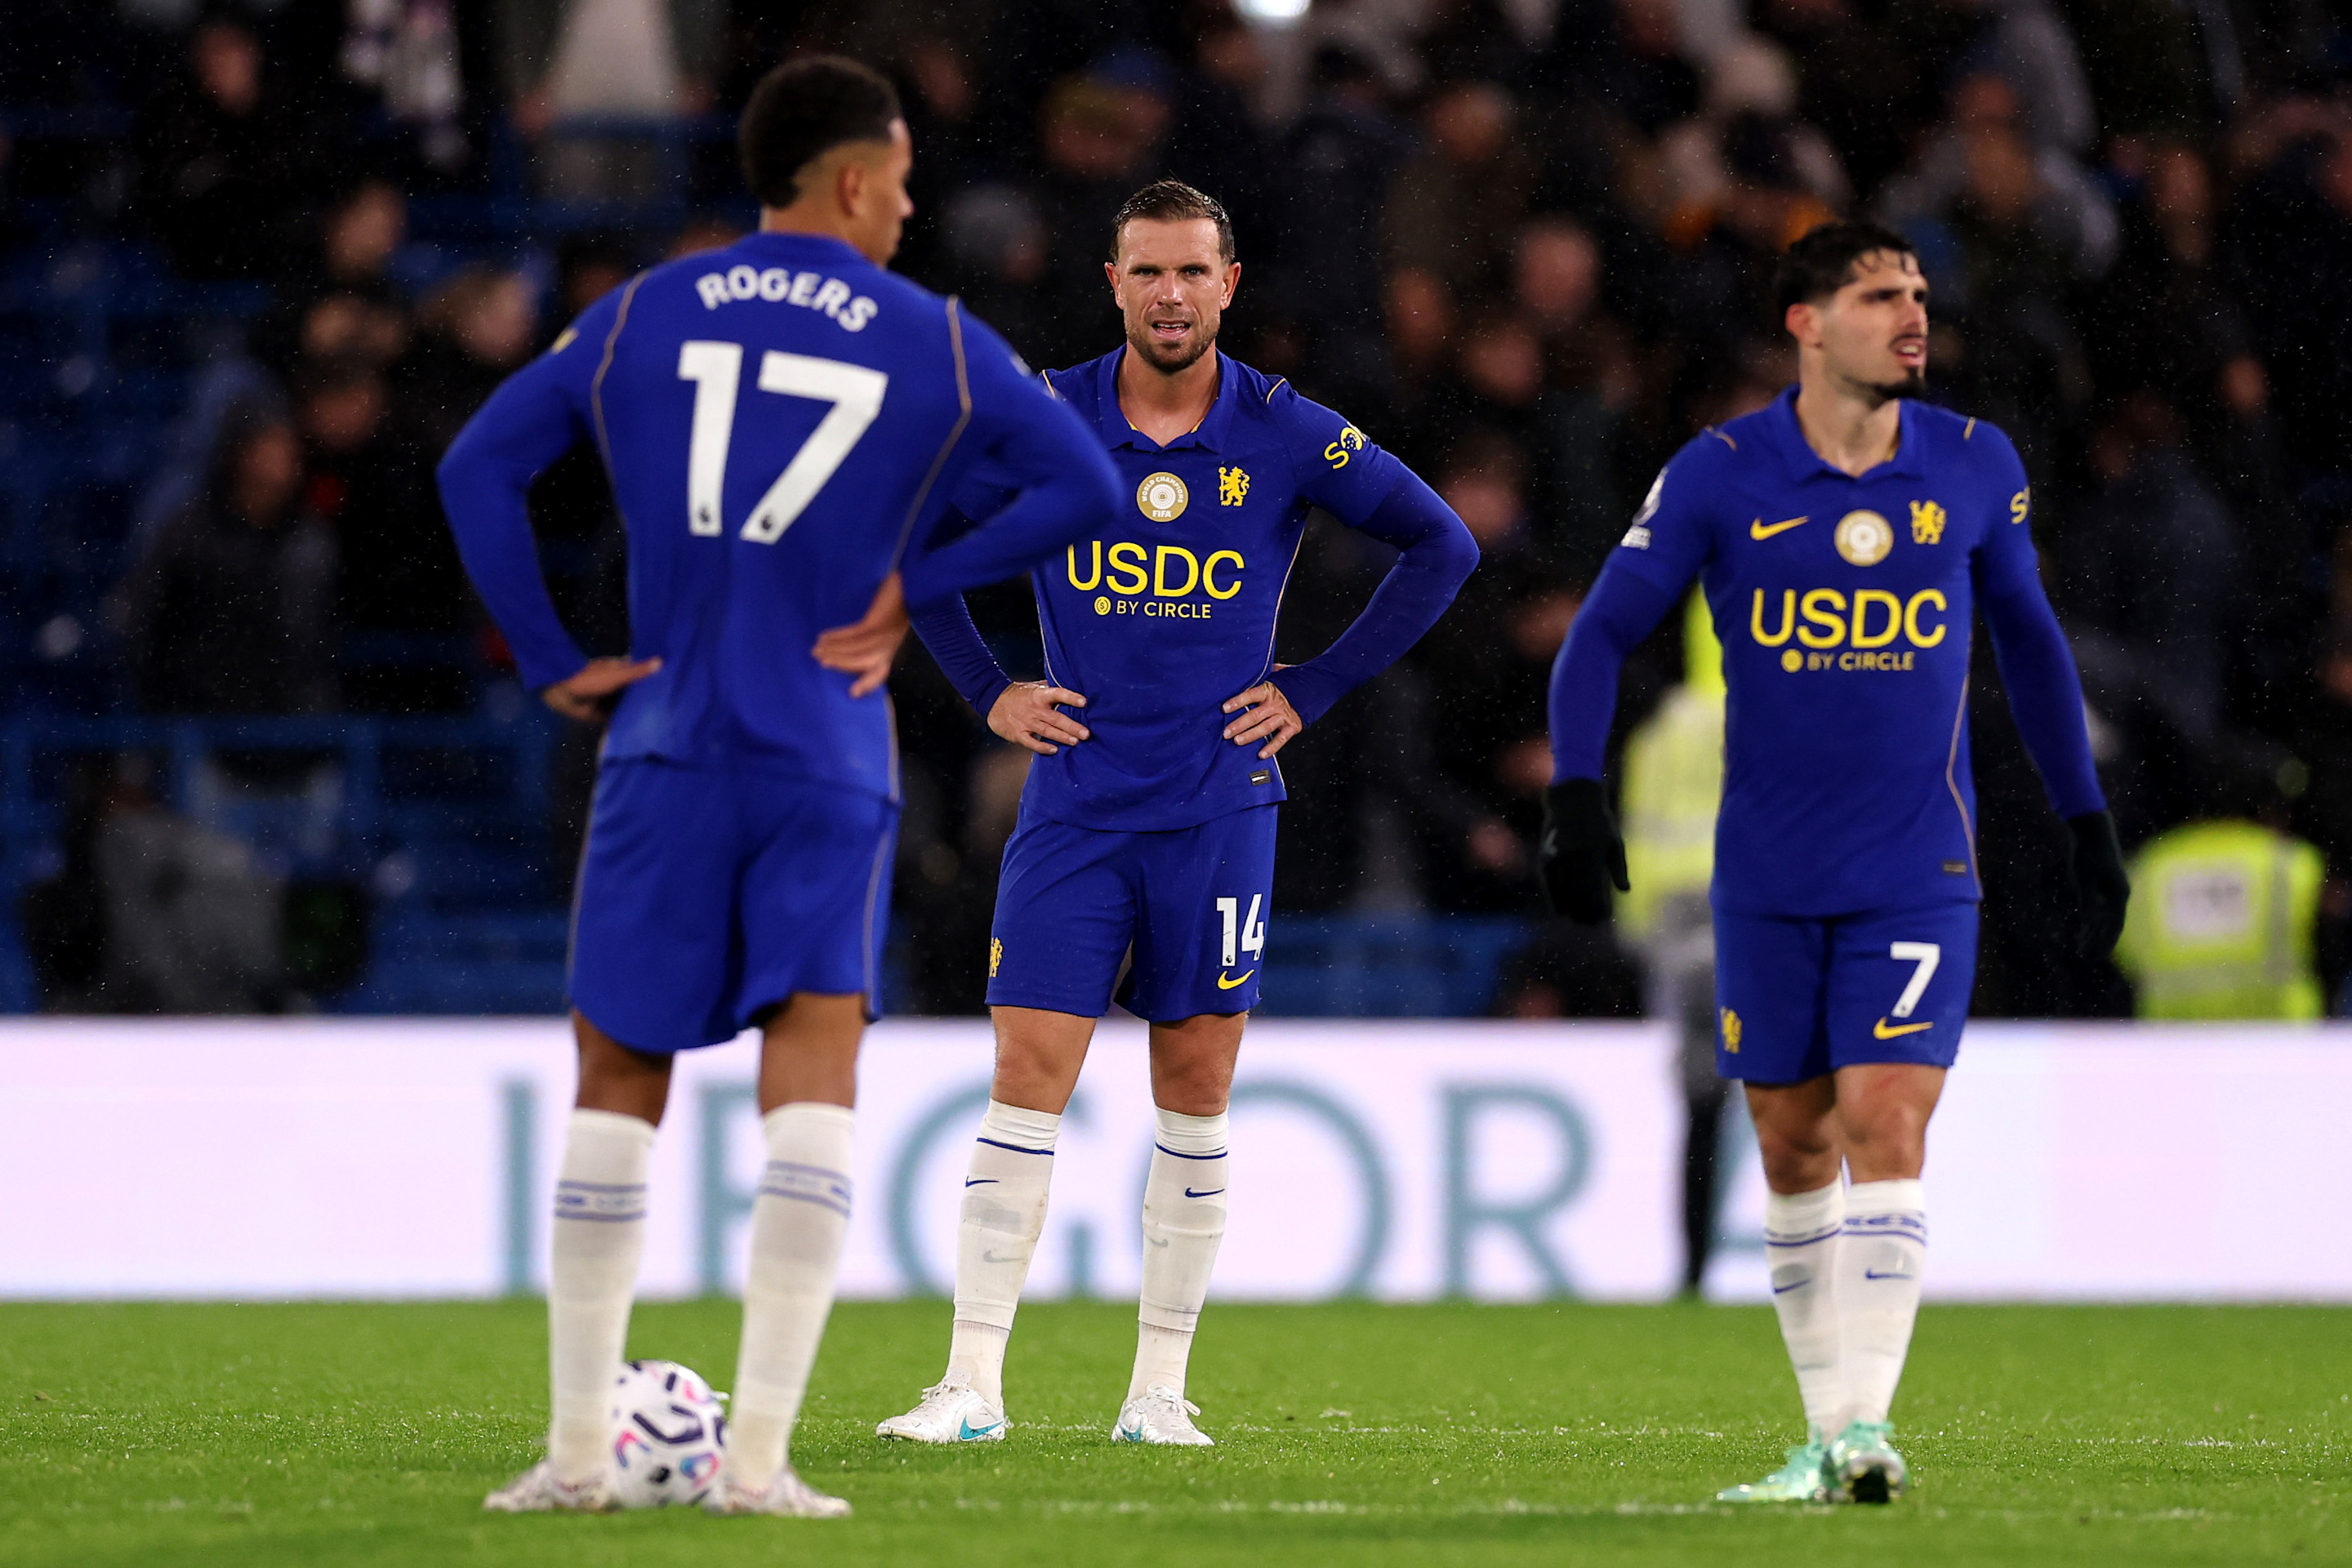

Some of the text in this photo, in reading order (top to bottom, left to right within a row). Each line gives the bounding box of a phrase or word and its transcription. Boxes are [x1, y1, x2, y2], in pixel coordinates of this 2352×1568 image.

[697, 265, 878, 332] ROGERS
[678, 341, 889, 544] 17
[1142, 476, 1184, 503] WORLD CHAMPIONS
[1152, 510, 1172, 518] FIFA
[1067, 541, 1245, 599] USDC
[1116, 600, 1139, 615] BY
[1143, 602, 1212, 619] CIRCLE
[1751, 588, 1947, 648] USDC
[1807, 652, 1914, 670] BY CIRCLE
[1216, 893, 1265, 967] 14
[1890, 941, 1940, 1018] 7
